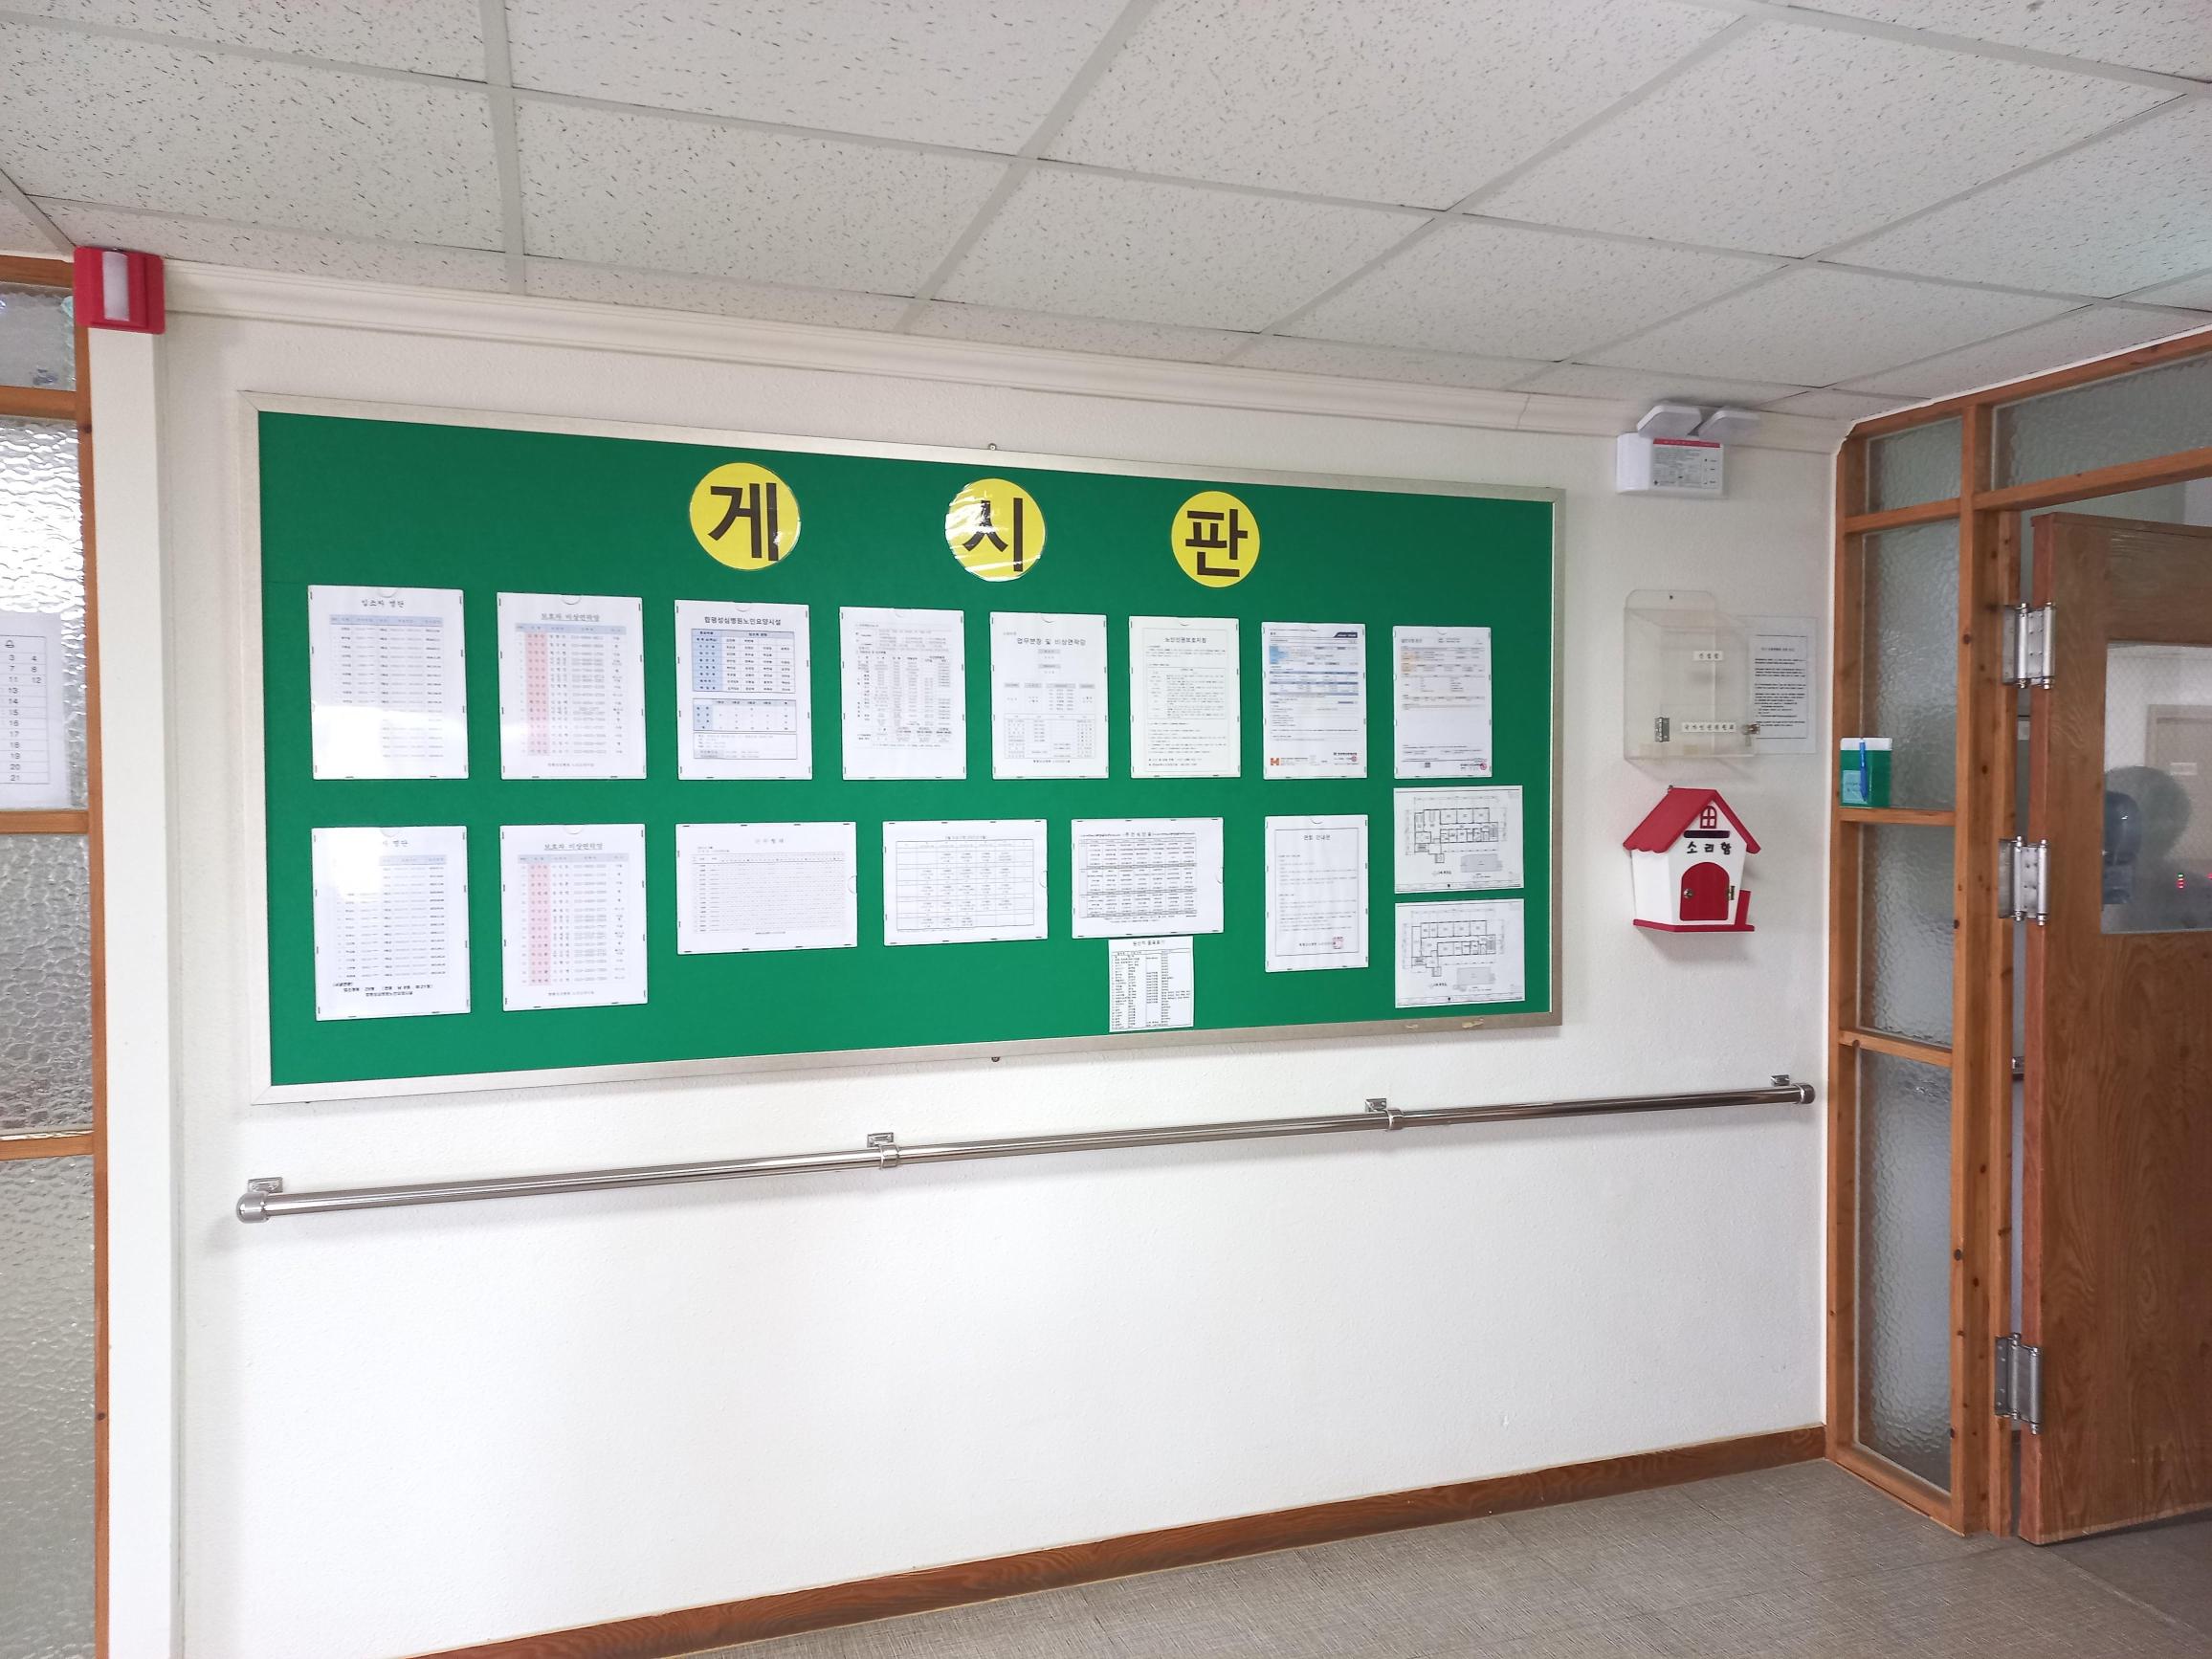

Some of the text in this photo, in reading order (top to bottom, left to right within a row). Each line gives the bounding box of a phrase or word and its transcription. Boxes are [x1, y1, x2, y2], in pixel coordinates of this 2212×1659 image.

[707, 482, 1249, 578] 게 시 판
[1687, 841, 1732, 855] 소리함
